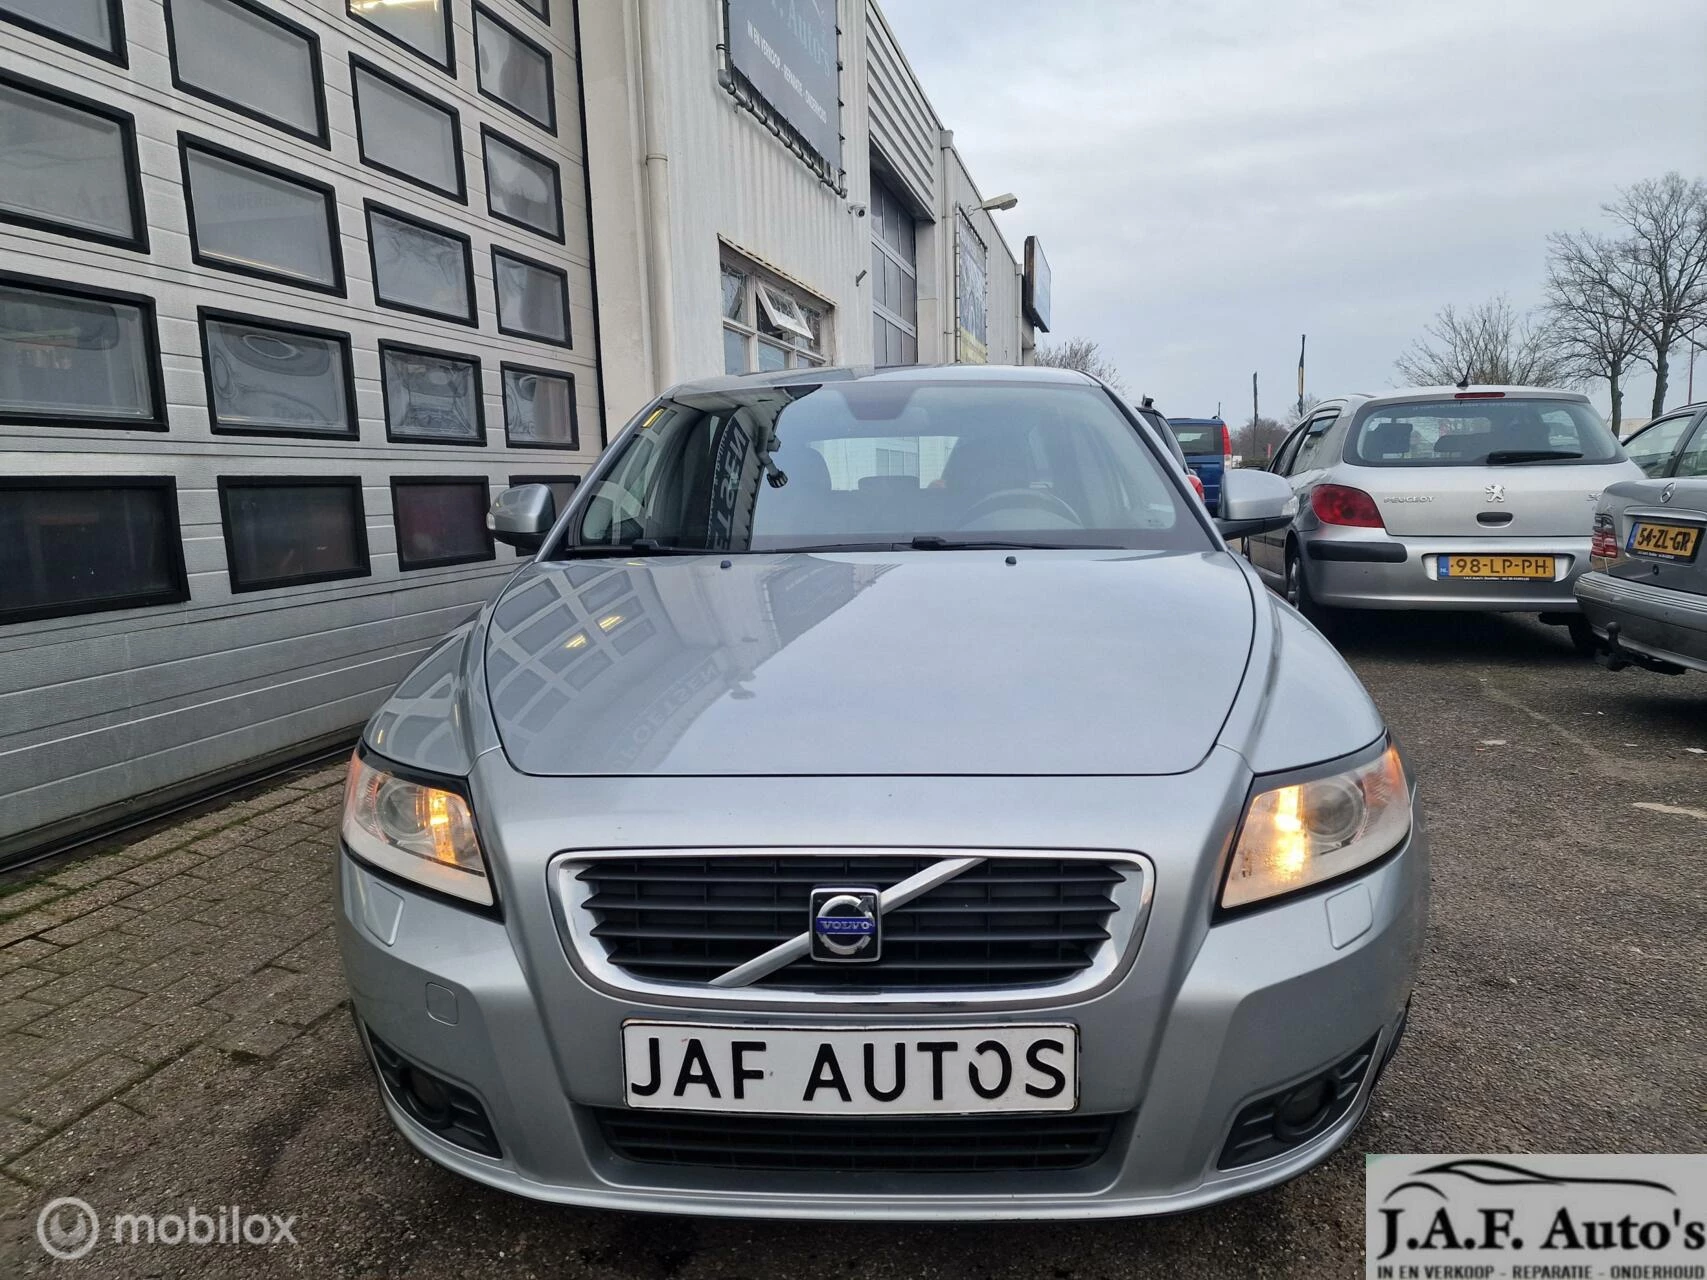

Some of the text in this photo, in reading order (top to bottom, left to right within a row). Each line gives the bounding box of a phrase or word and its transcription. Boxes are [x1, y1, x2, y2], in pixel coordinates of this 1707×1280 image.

[1383, 495, 1435, 503] PEUGEOT
[1637, 527, 1692, 552] 54-ZL-GR
[1456, 558, 1547, 574] 98-LP-PH
[821, 921, 870, 930] VOLVO
[631, 1037, 1067, 1103] JAF AUTOS
